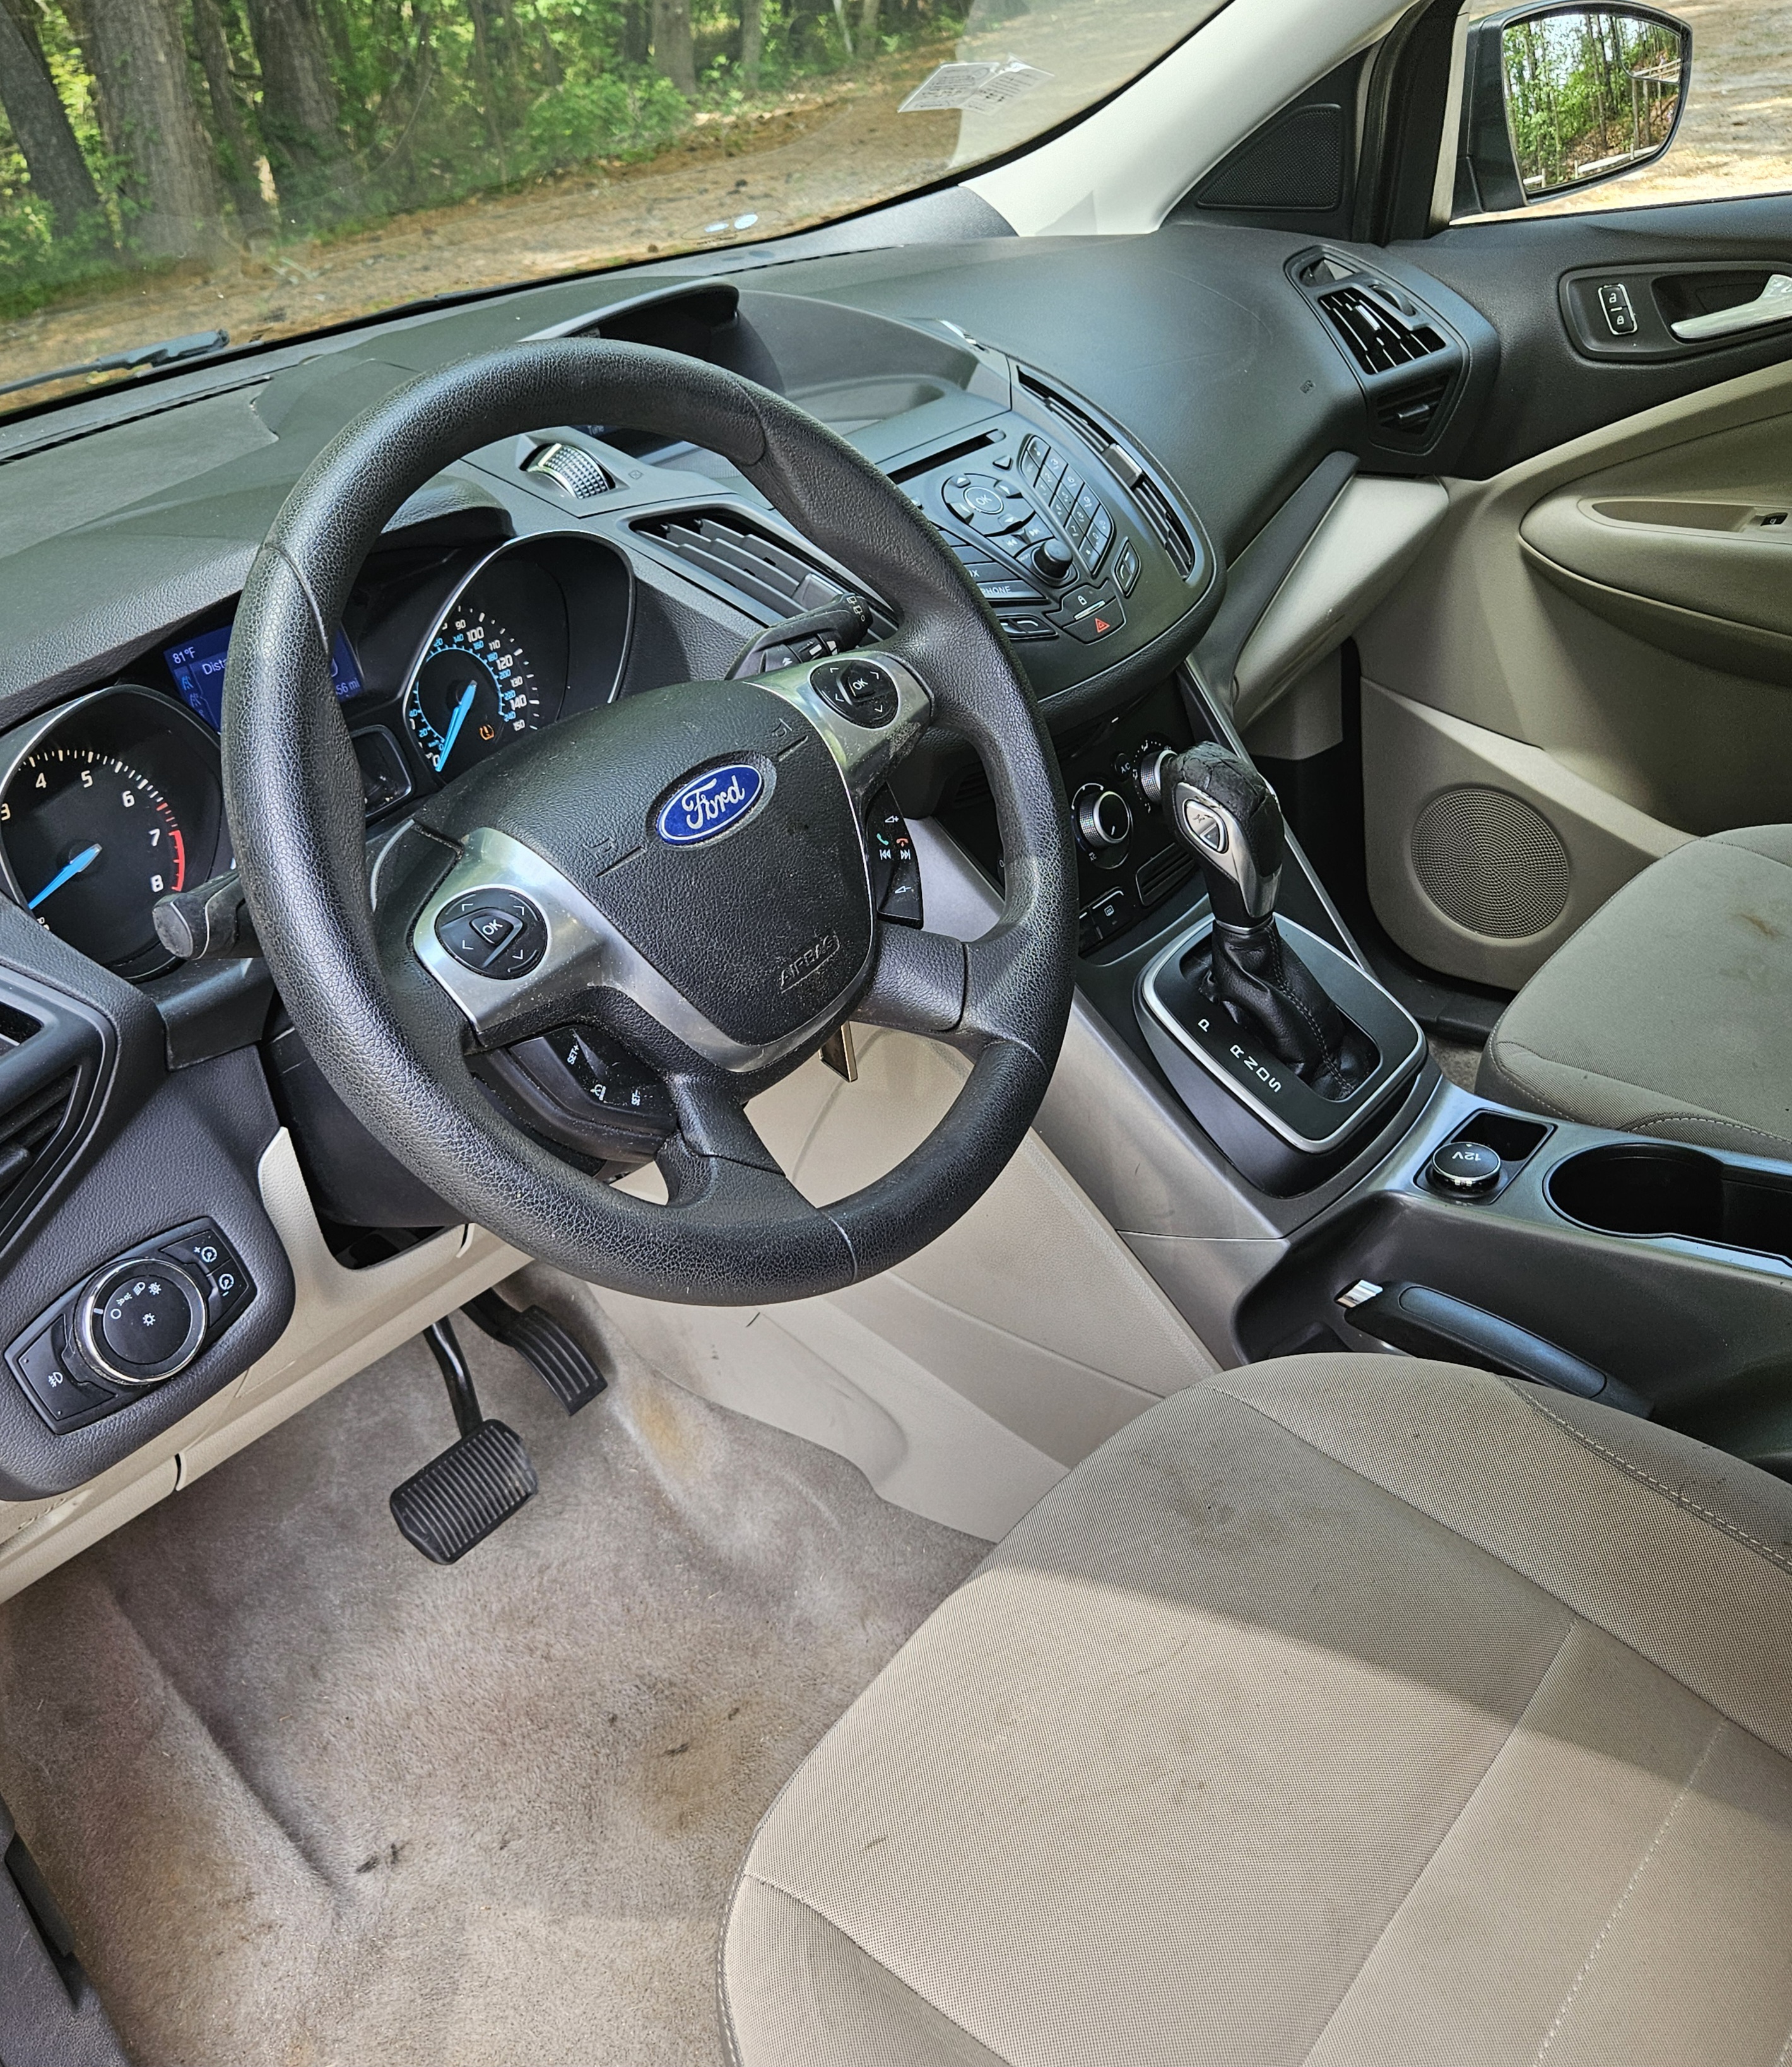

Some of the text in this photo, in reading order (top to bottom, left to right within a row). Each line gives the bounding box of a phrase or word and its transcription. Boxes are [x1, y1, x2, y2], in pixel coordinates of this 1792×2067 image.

[975, 493, 993, 505] OK
[980, 586, 1011, 595] PHONE
[455, 619, 466, 630] 90
[433, 637, 443, 647] 20
[466, 626, 485, 643] 100
[488, 639, 501, 651] 110
[172, 646, 196, 664] 81°F
[495, 654, 514, 671] 120
[348, 677, 360, 690] mi
[510, 676, 523, 688] 130
[852, 677, 869, 690] OK
[509, 693, 528, 711] 140
[512, 719, 525, 731] 150
[35, 772, 47, 789] 4
[81, 770, 93, 788] 5
[121, 791, 135, 808] 6
[681, 775, 745, 830] Ford
[1, 803, 11, 821] 3
[148, 828, 160, 847] 7
[150, 874, 163, 892] 8
[482, 919, 503, 935] OK
[1198, 1018, 1210, 1032] P
[567, 1044, 580, 1065] SET+
[1230, 1044, 1244, 1059] R
[1243, 1056, 1258, 1071] N
[1256, 1066, 1270, 1081] D
[1268, 1077, 1282, 1093] S
[1451, 1151, 1482, 1162] 12V
